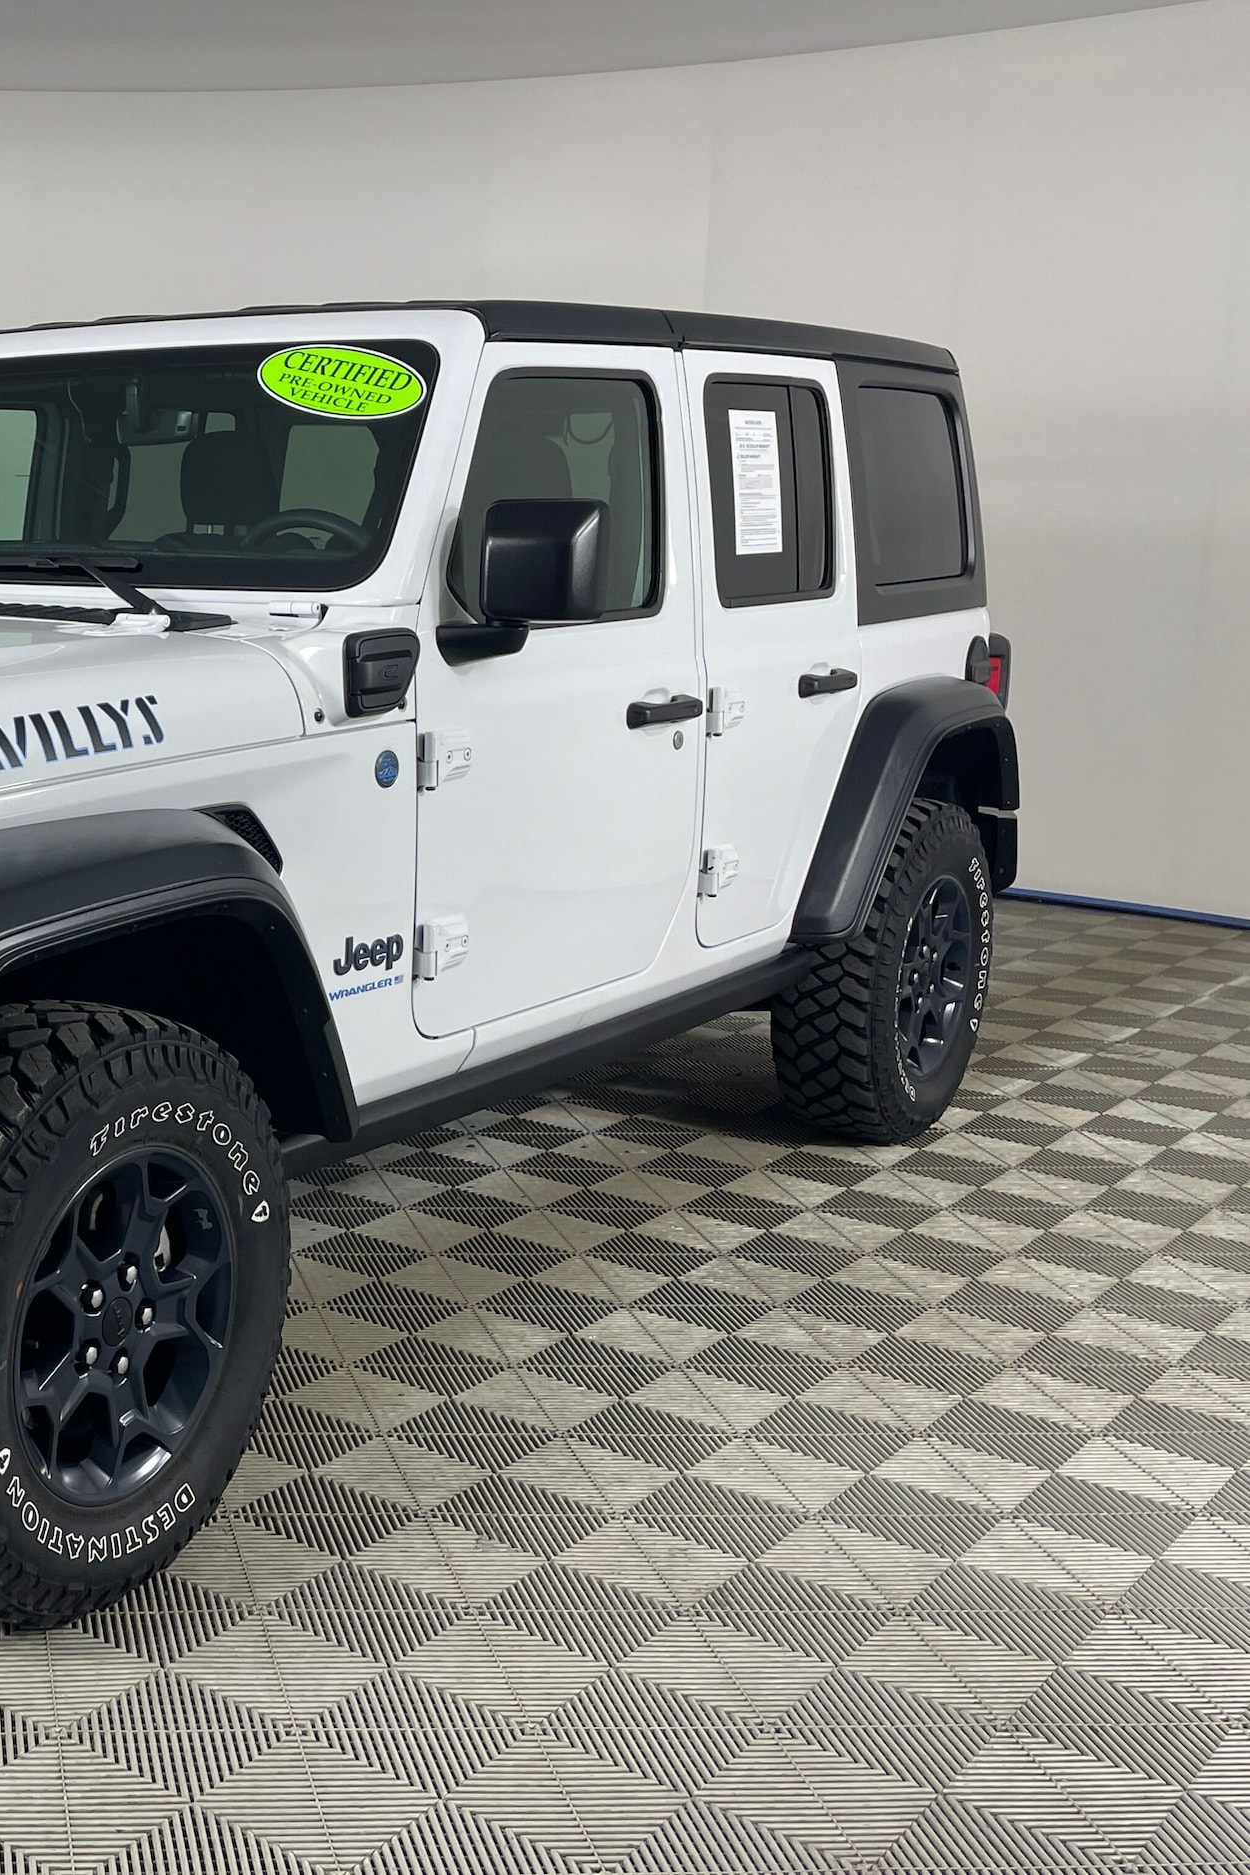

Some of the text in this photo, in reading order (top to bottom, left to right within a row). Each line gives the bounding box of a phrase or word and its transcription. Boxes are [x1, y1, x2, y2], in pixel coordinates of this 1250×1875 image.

[278, 373, 392, 404] PRE-OWNED
[284, 351, 412, 391] CERTIFIED
[290, 386, 369, 413] VEHICLE
[333, 933, 404, 976] Jeep
[328, 977, 392, 1001] WRANGLER
[90, 1102, 261, 1195] Firestone
[6, 1482, 196, 1563] DESTINATION
